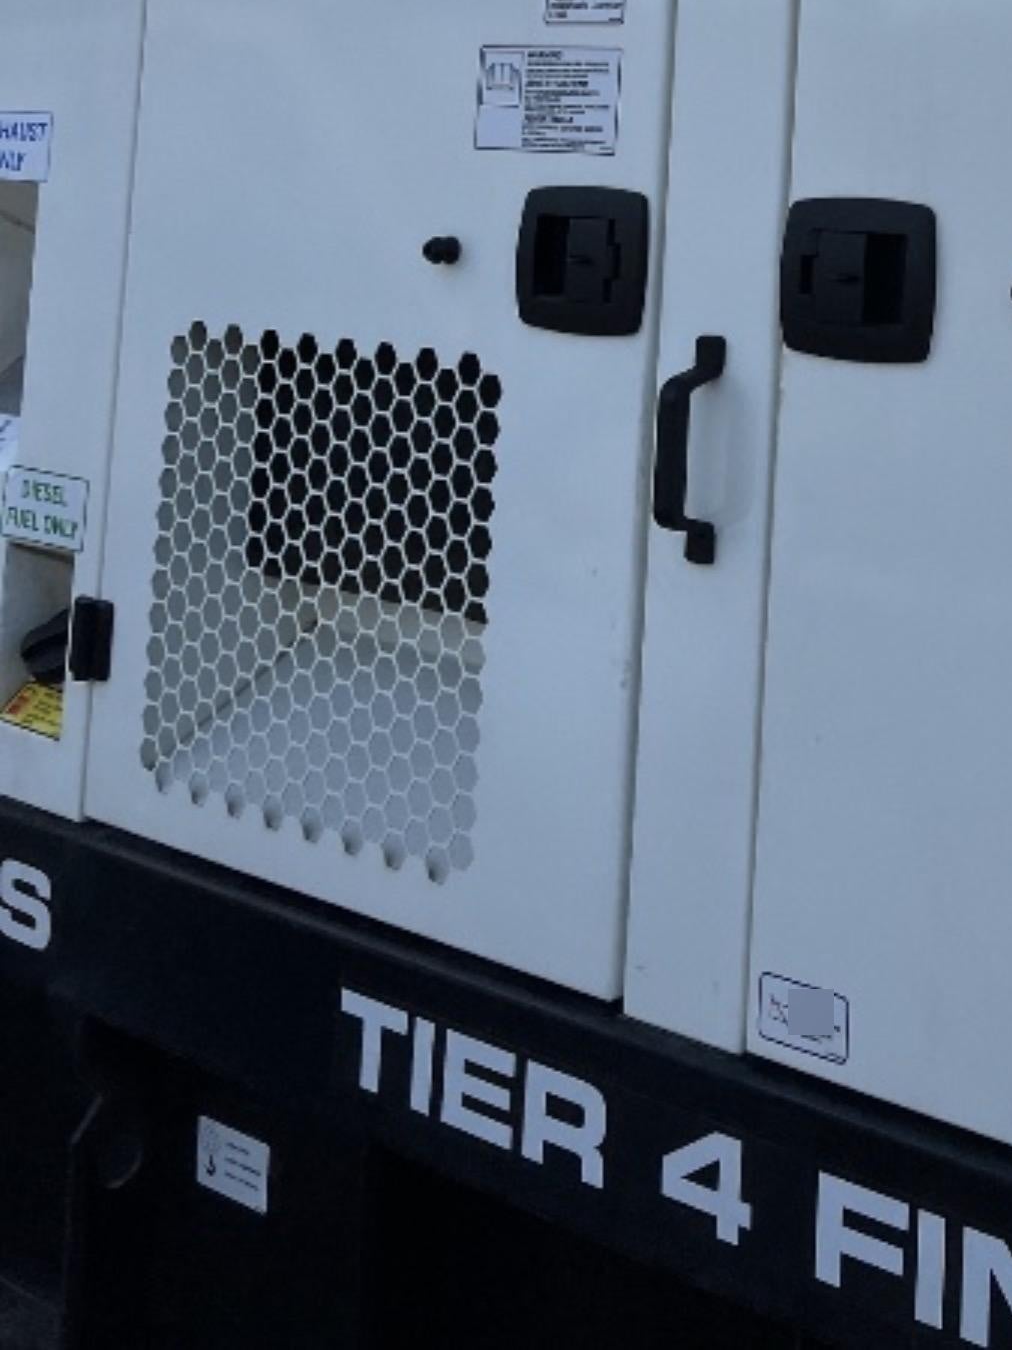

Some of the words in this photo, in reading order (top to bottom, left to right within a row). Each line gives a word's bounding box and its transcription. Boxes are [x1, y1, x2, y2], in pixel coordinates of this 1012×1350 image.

[0, 858, 52, 950] S
[340, 986, 607, 1189] TIER
[661, 1130, 751, 1246] 4
